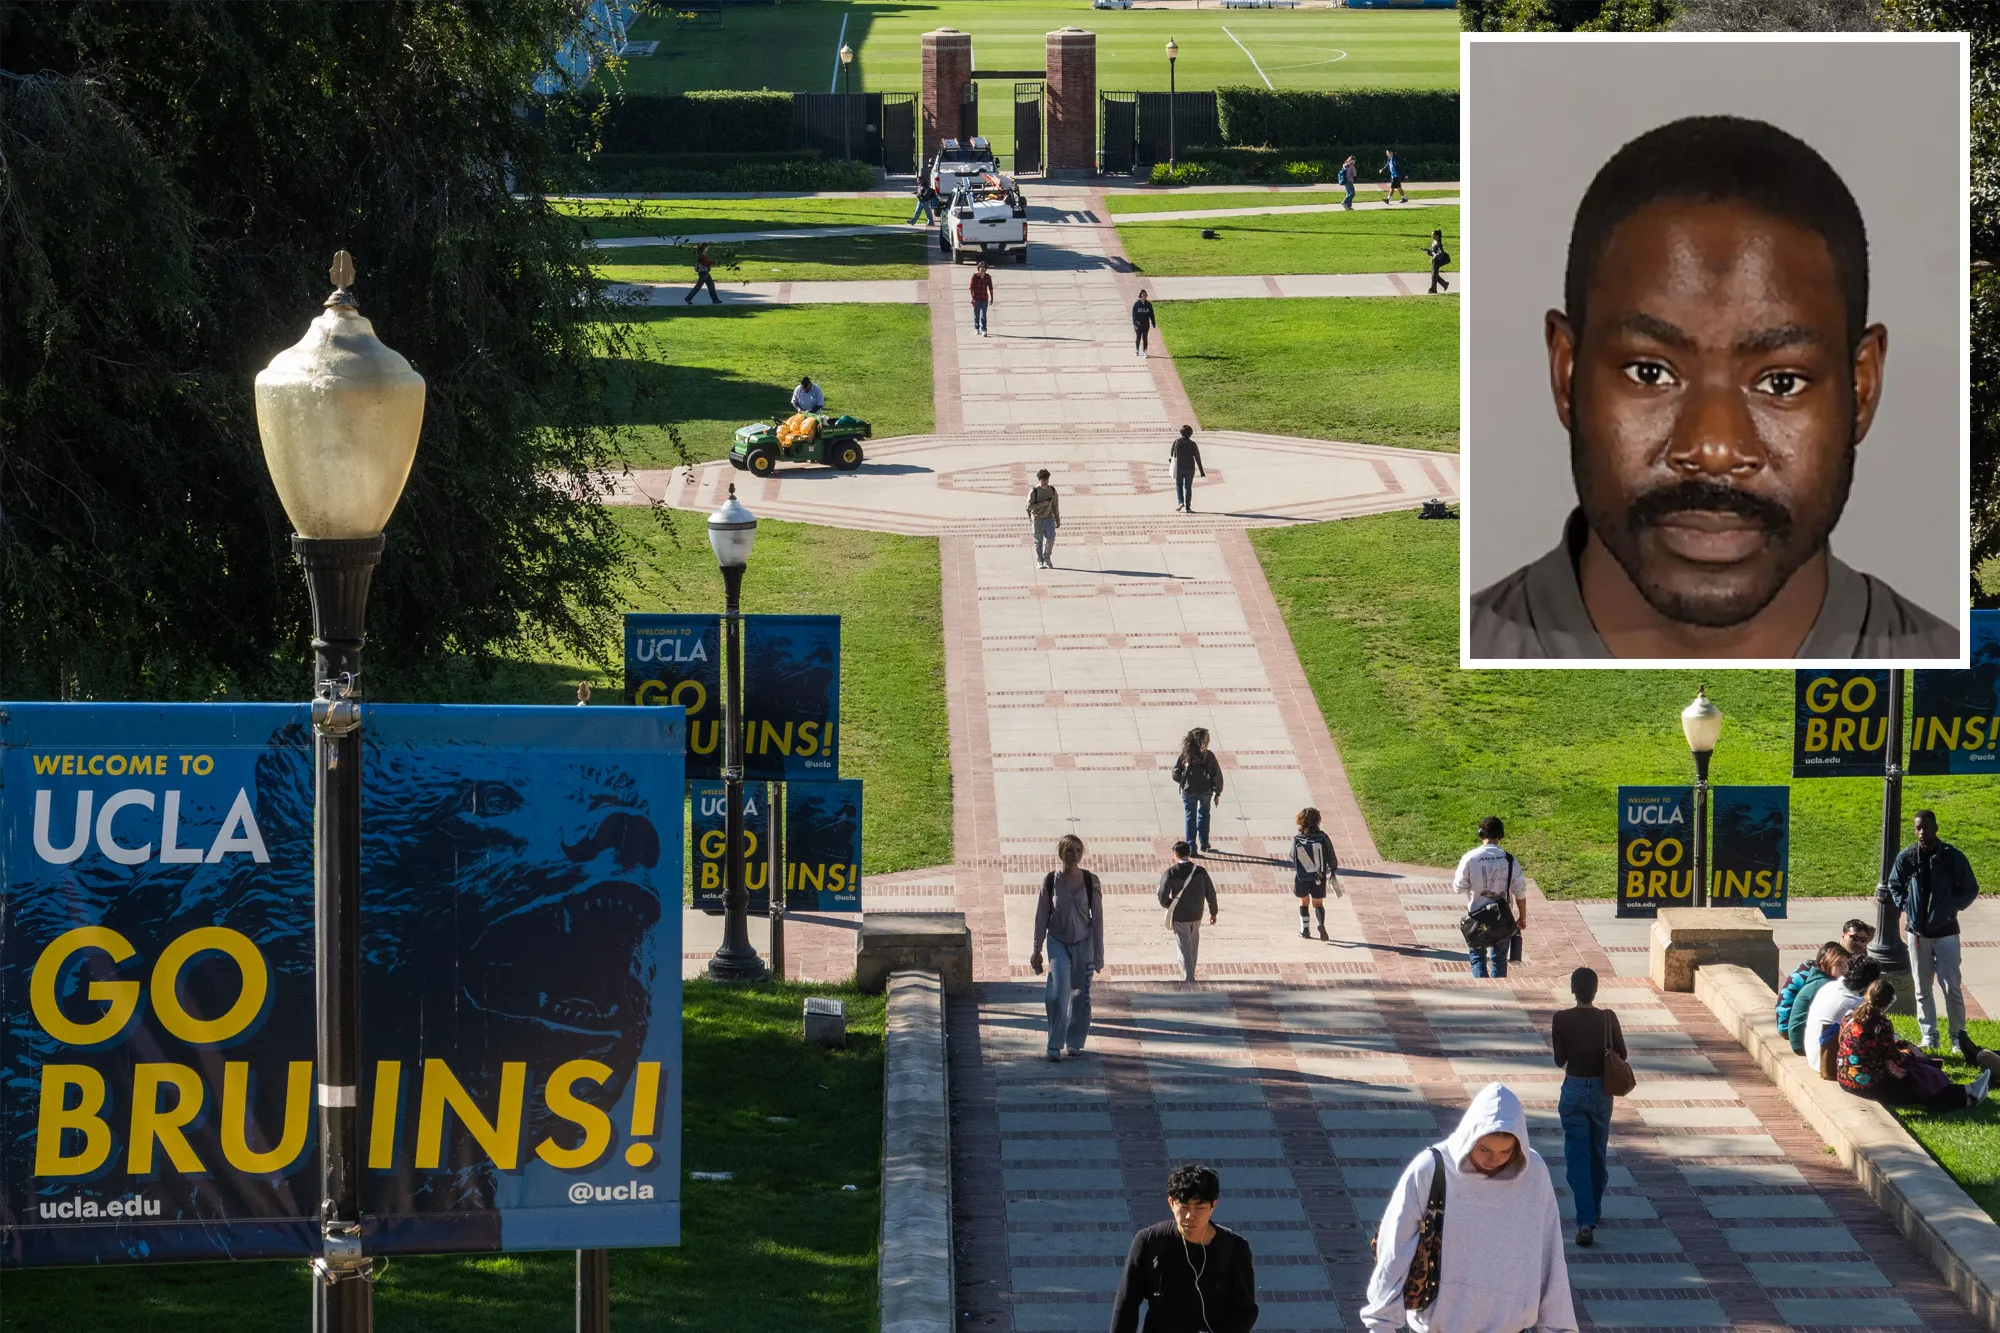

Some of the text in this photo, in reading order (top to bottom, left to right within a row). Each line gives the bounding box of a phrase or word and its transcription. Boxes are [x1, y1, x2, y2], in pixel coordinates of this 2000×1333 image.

[637, 628, 692, 636] WELCOME TO
[636, 638, 708, 662] UCLA
[635, 679, 707, 716] GO
[1805, 676, 1877, 713] GO
[33, 755, 214, 776] WELCOME TO
[804, 760, 832, 769] @ucla
[1805, 756, 1841, 765] ucla.edu
[1969, 753, 1996, 761] @ucla
[701, 788, 727, 796] WELCO
[701, 797, 758, 817] UCA
[1627, 804, 1685, 825] UCLA
[33, 787, 271, 865] UCLA
[1626, 837, 1684, 867] GO
[834, 894, 856, 902] @ucla
[1626, 901, 1657, 909] ucla.edu
[1759, 901, 1782, 909] @ucla
[29, 925, 269, 1046] GO
[567, 1180, 655, 1206] @ucla
[39, 1194, 161, 1220] ucla.edu
